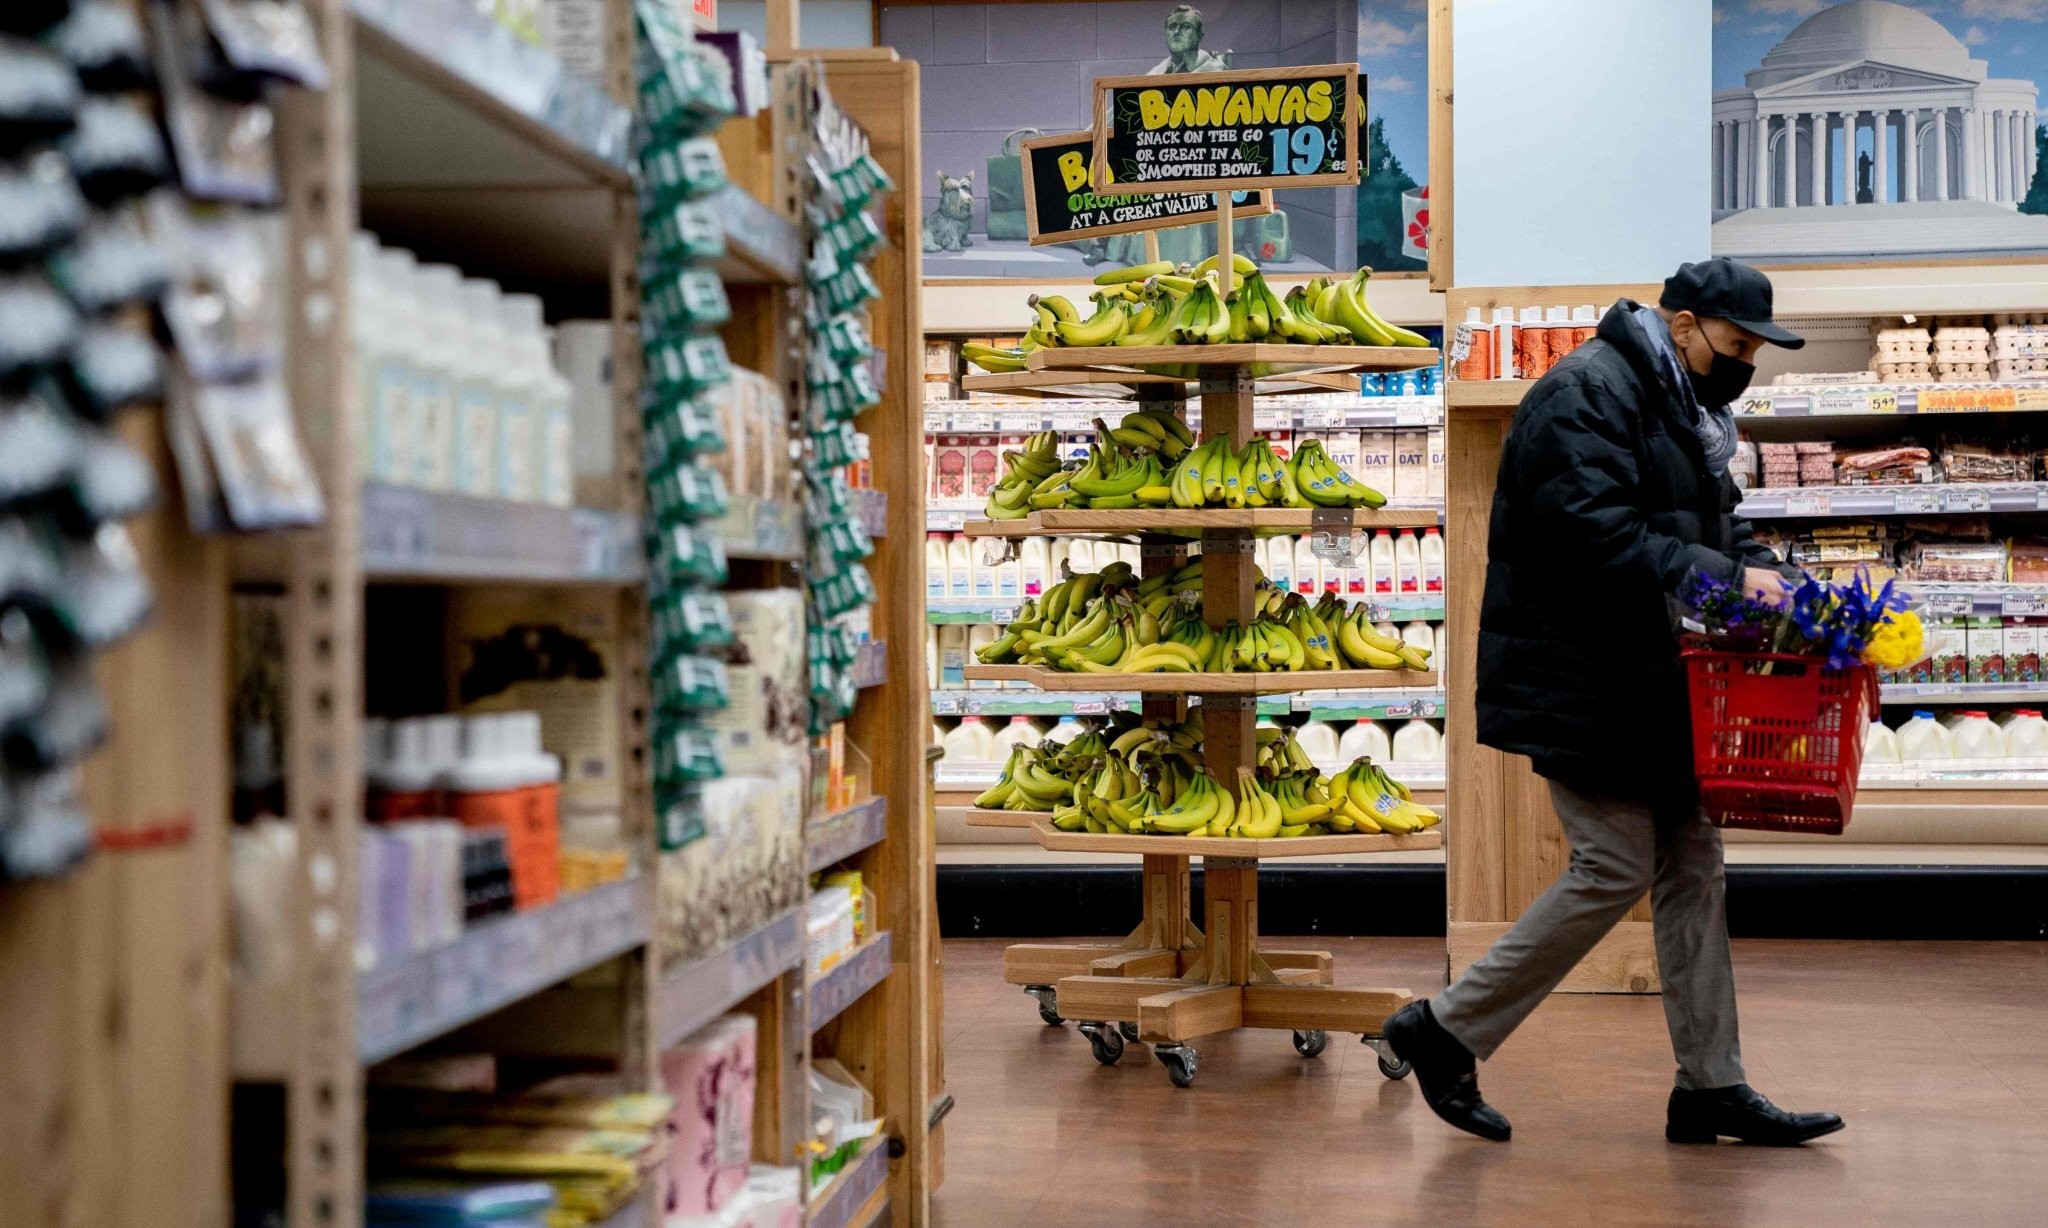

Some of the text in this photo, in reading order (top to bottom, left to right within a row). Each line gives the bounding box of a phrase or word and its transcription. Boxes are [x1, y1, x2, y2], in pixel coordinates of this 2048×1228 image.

[1139, 80, 1332, 130] BANANAS
[1136, 128, 1263, 146] SNACK ON THE GO
[1136, 147, 1242, 162] OR GREAT IN A
[1137, 161, 1261, 180] SMOOTHIE BOWL
[1070, 212, 1093, 229] AT
[1097, 209, 1110, 225] A
[1113, 202, 1164, 221] GREAT
[1164, 194, 1208, 215] VALUE
[1365, 454, 1389, 465] OAT
[1399, 454, 1423, 465] OAT
